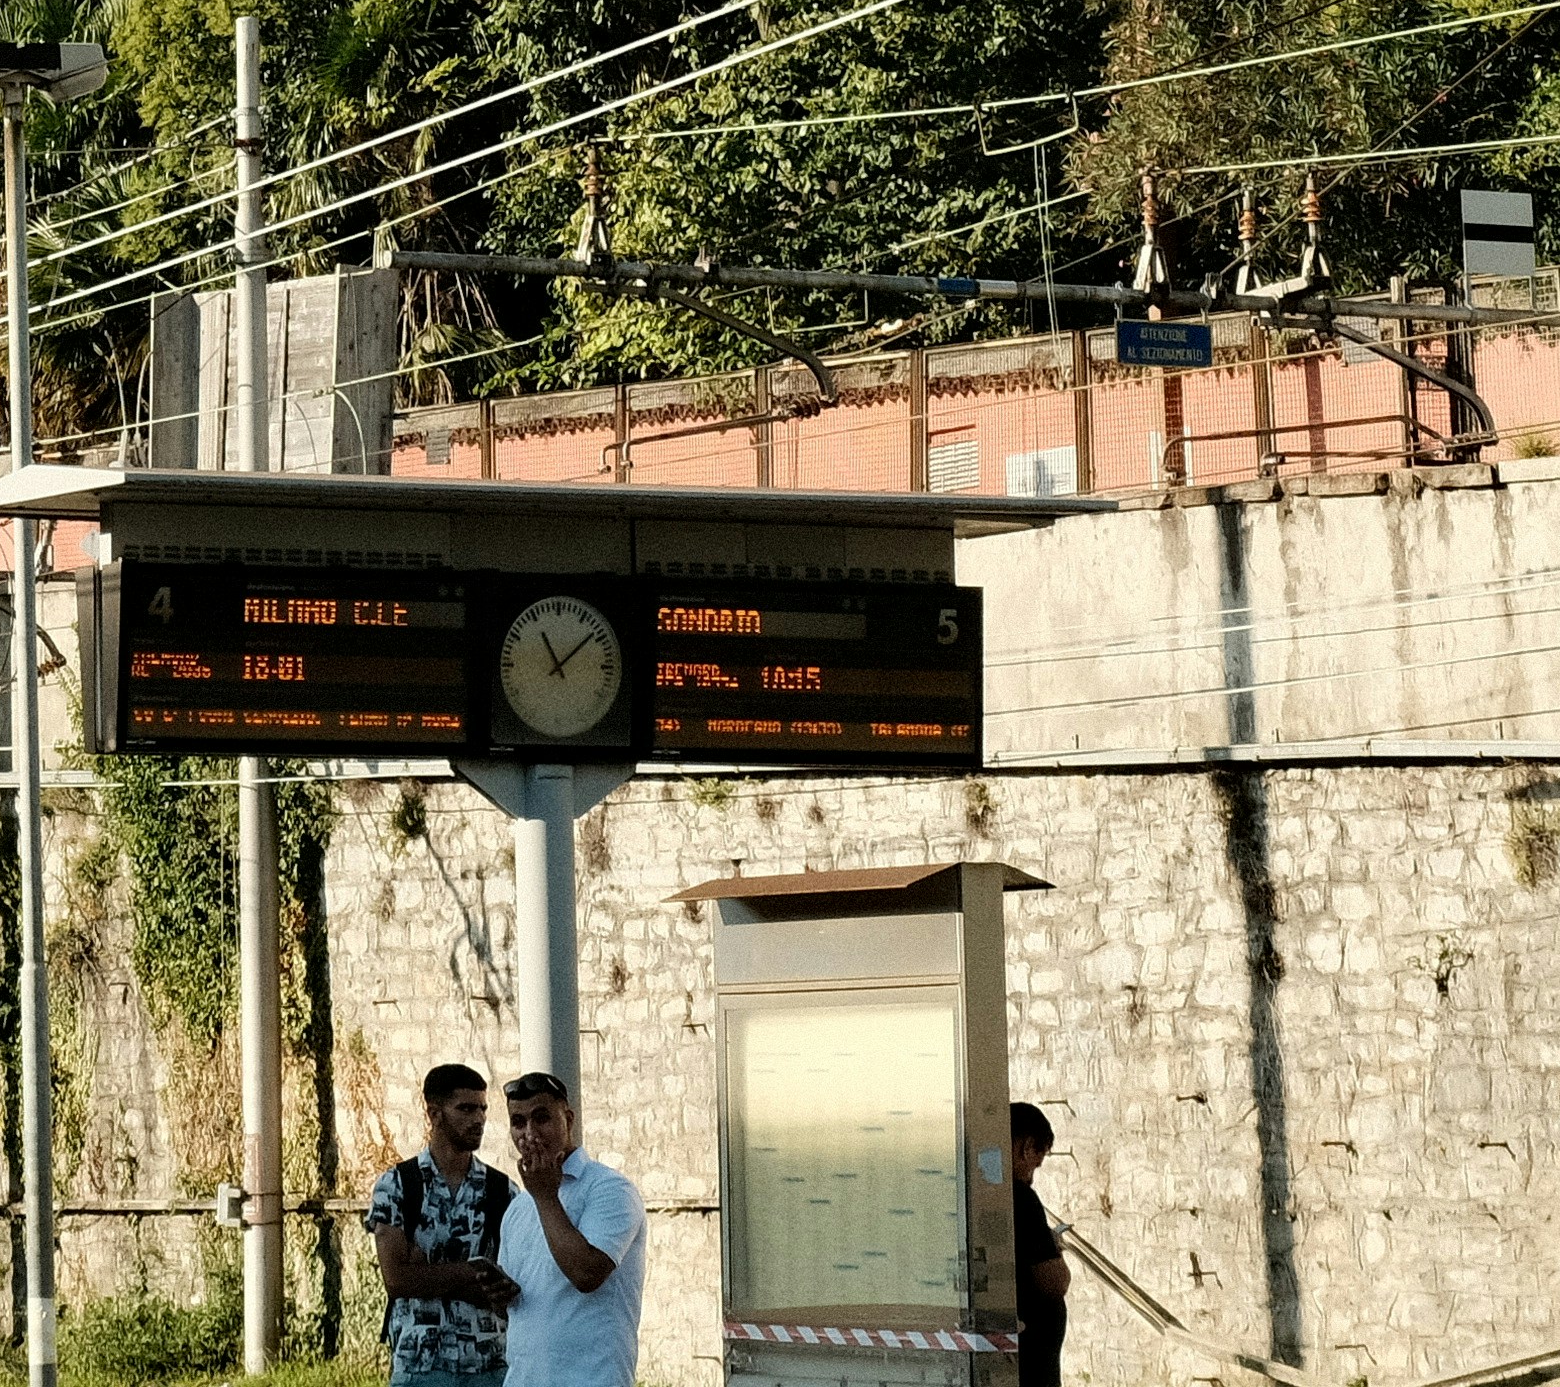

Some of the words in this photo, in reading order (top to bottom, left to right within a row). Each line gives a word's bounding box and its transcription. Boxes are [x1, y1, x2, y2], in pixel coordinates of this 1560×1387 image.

[148, 586, 175, 624] 4
[244, 598, 337, 624] MILANO
[937, 608, 959, 645] 5
